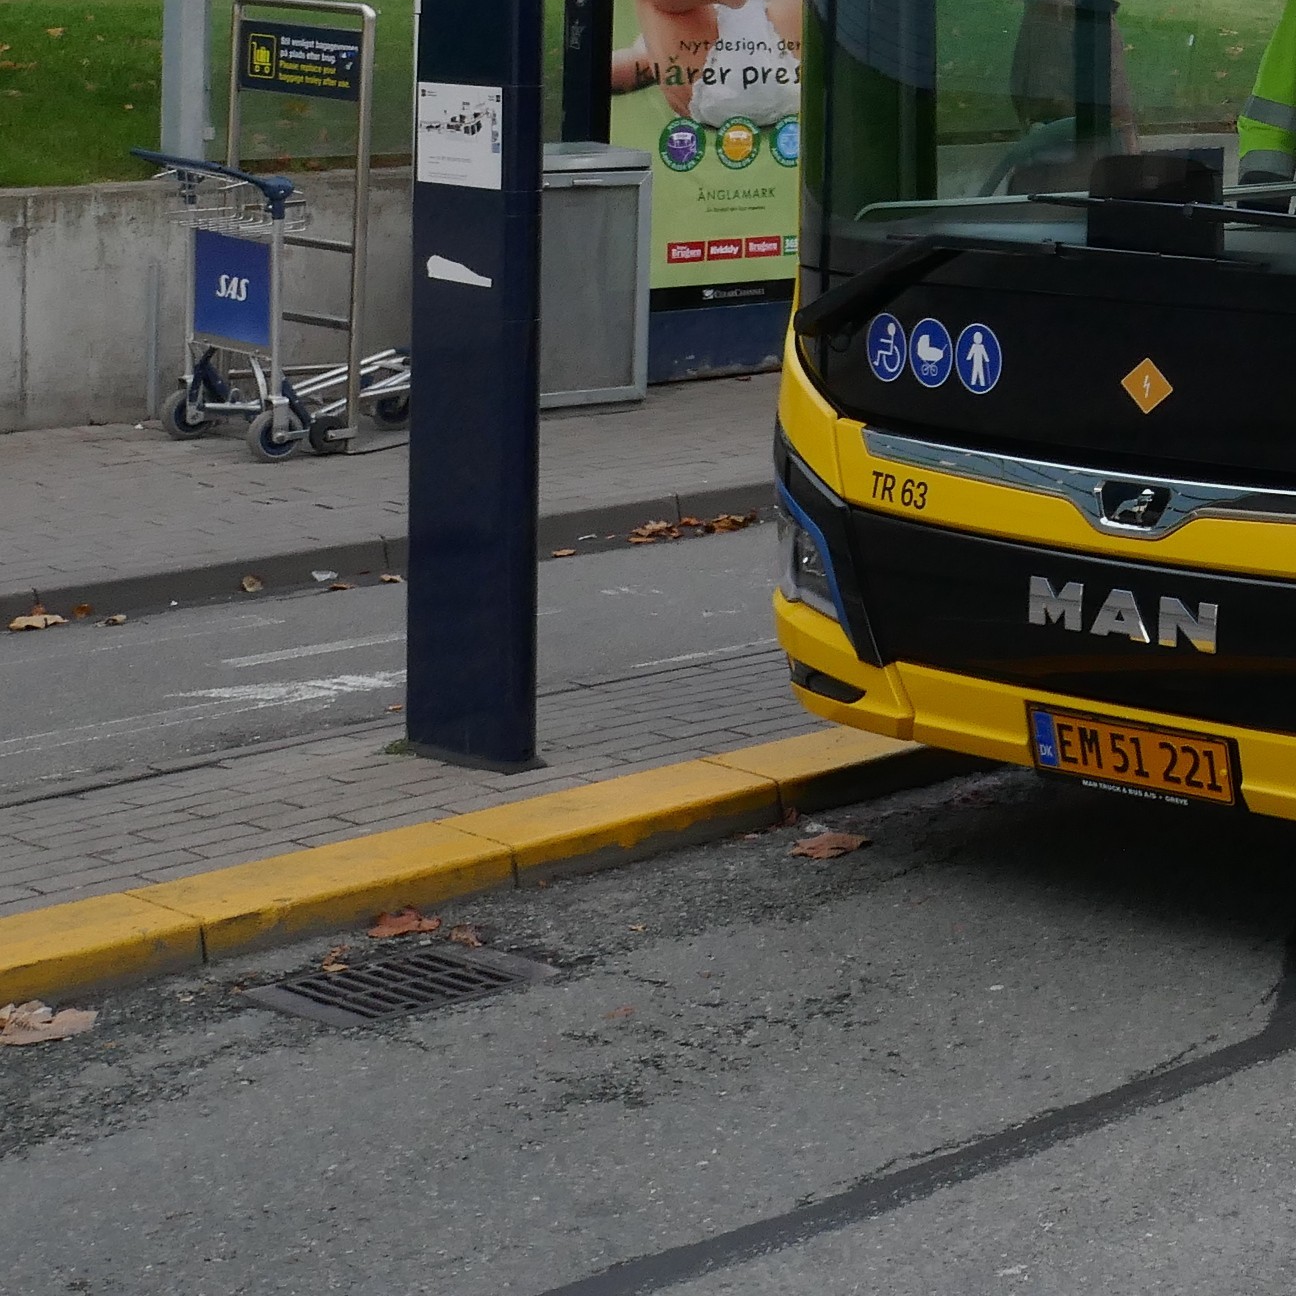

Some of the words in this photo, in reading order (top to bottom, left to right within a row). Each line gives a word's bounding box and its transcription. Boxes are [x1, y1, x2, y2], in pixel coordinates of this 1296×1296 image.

[680, 39, 711, 54] Nyt
[715, 37, 773, 55] design,
[216, 274, 250, 302] SAS
[870, 470, 894, 504] TR
[900, 478, 928, 510] 63
[1028, 574, 1219, 654] MAN
[1039, 744, 1054, 757] DK
[1056, 722, 1103, 770] EM
[1108, 732, 1150, 779] 51
[1158, 741, 1223, 794] 221
[1082, 779, 1098, 789] MAN
[1099, 782, 1121, 793] TRUCK
[1128, 788, 1143, 797] BUS
[1165, 794, 1189, 806] GREVE
